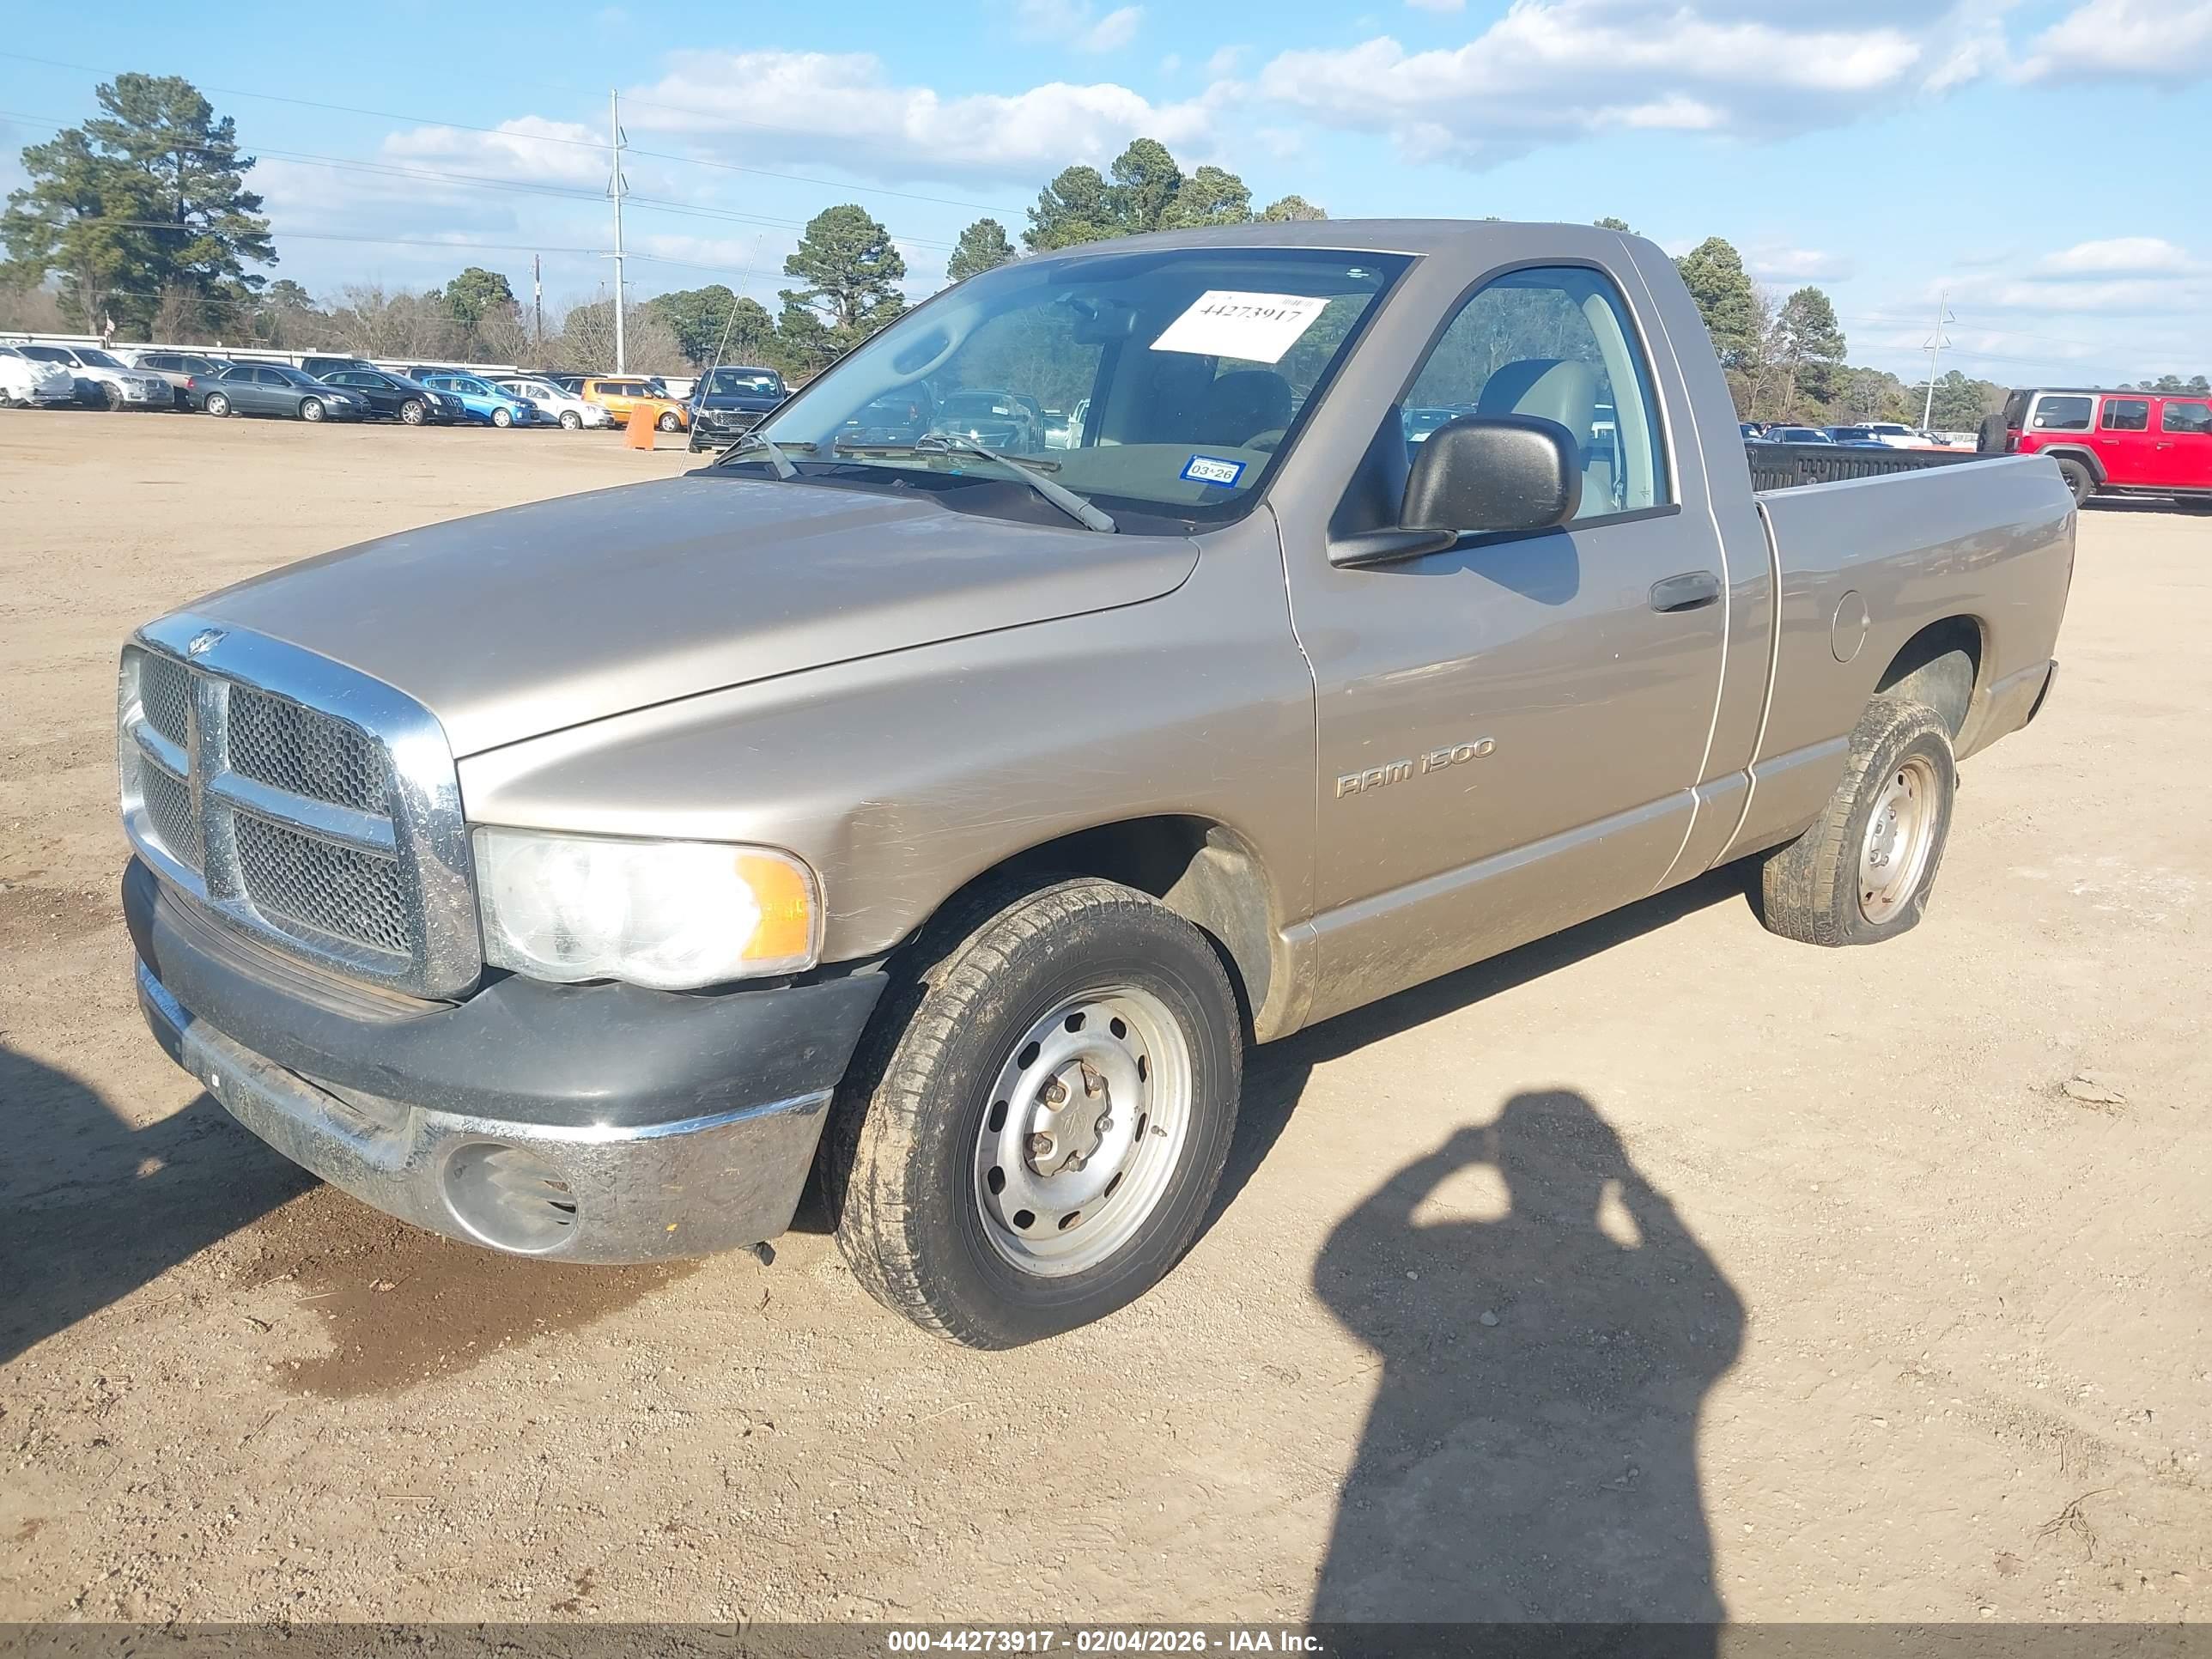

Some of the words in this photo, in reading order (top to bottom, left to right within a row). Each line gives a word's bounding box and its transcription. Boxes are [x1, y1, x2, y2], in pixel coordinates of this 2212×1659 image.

[1200, 304, 1303, 322] 44273917
[1334, 758, 1414, 799] RAM
[1421, 735, 1498, 775] 1500
